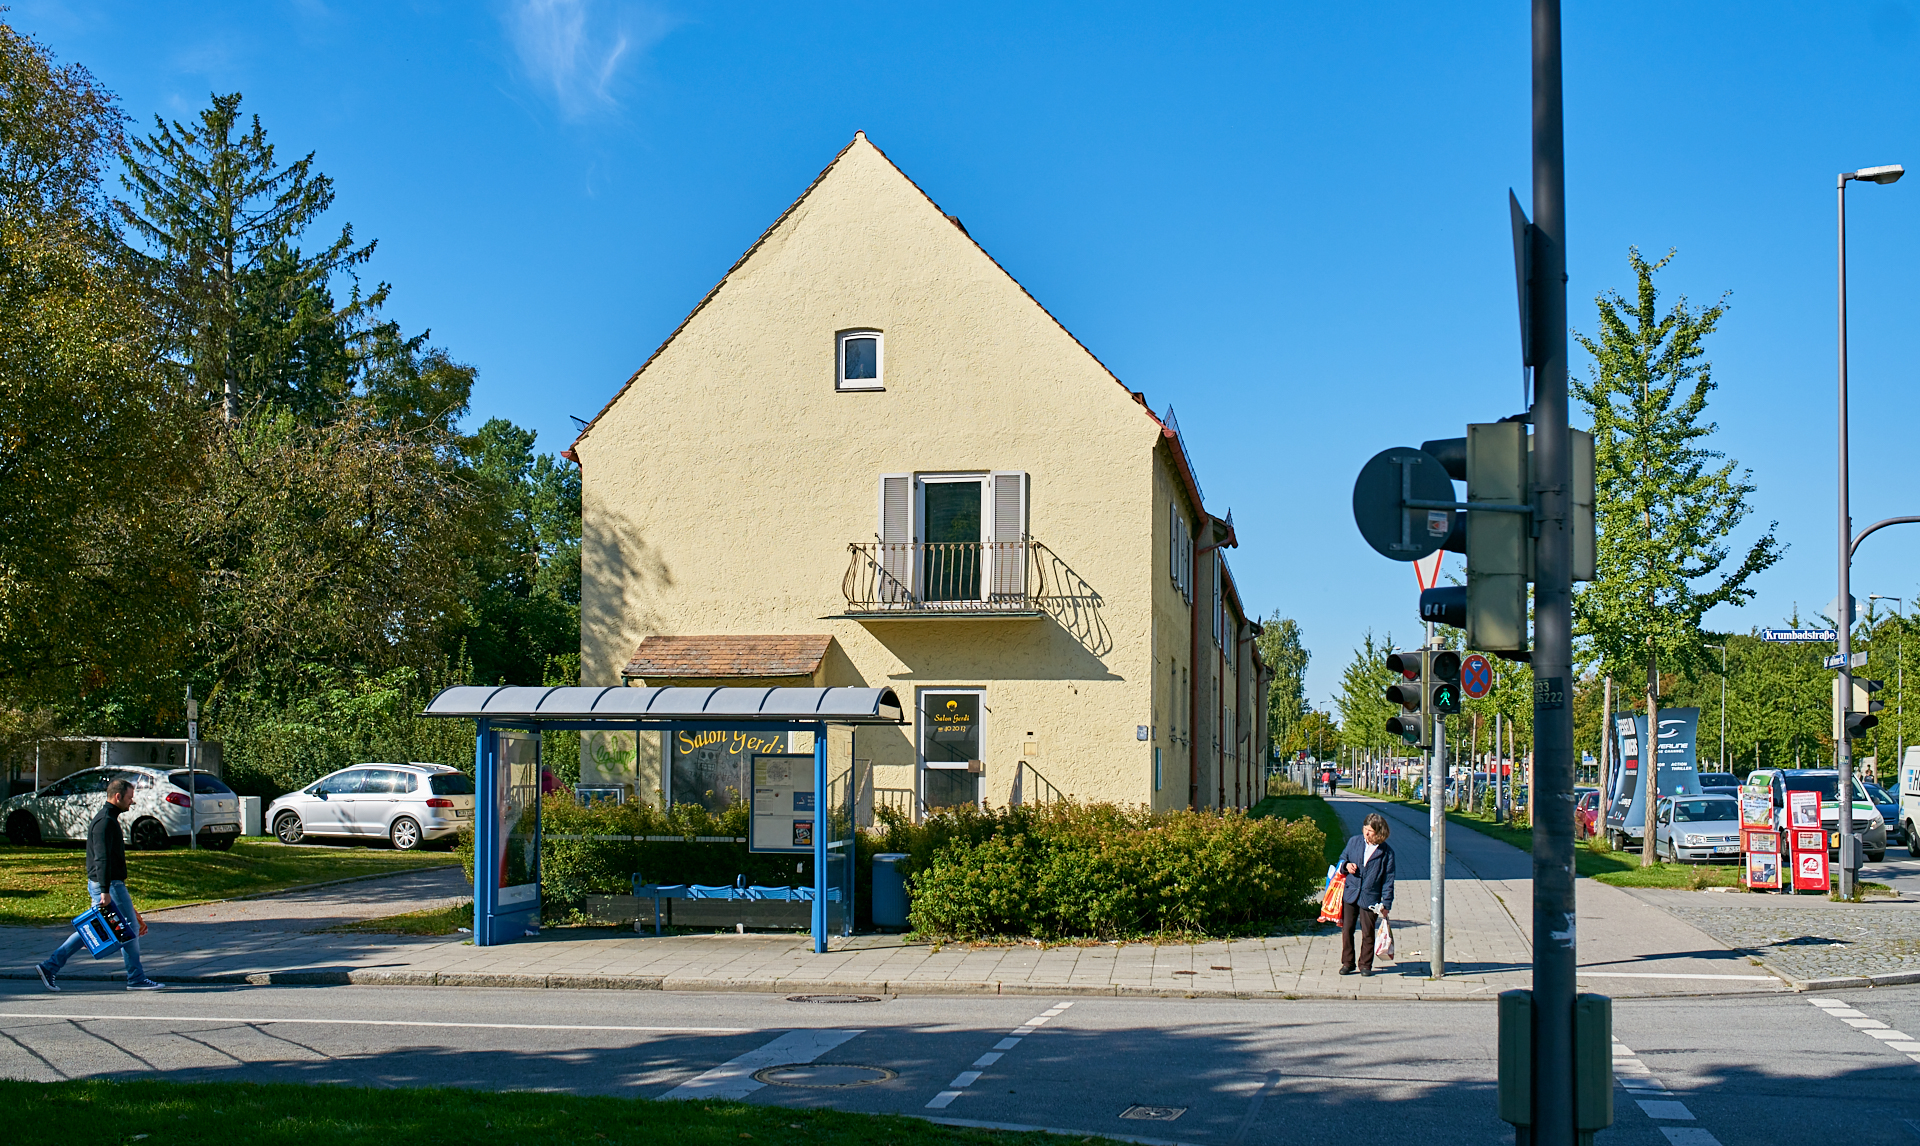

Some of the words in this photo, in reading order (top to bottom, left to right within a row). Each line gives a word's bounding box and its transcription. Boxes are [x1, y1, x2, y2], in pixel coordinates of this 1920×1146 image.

[1424, 604, 1446, 616] 041
[1766, 630, 1836, 641] Krumbadstraße
[934, 714, 952, 722] Salon
[952, 713, 970, 724] Gerdi
[678, 730, 728, 755] Salon
